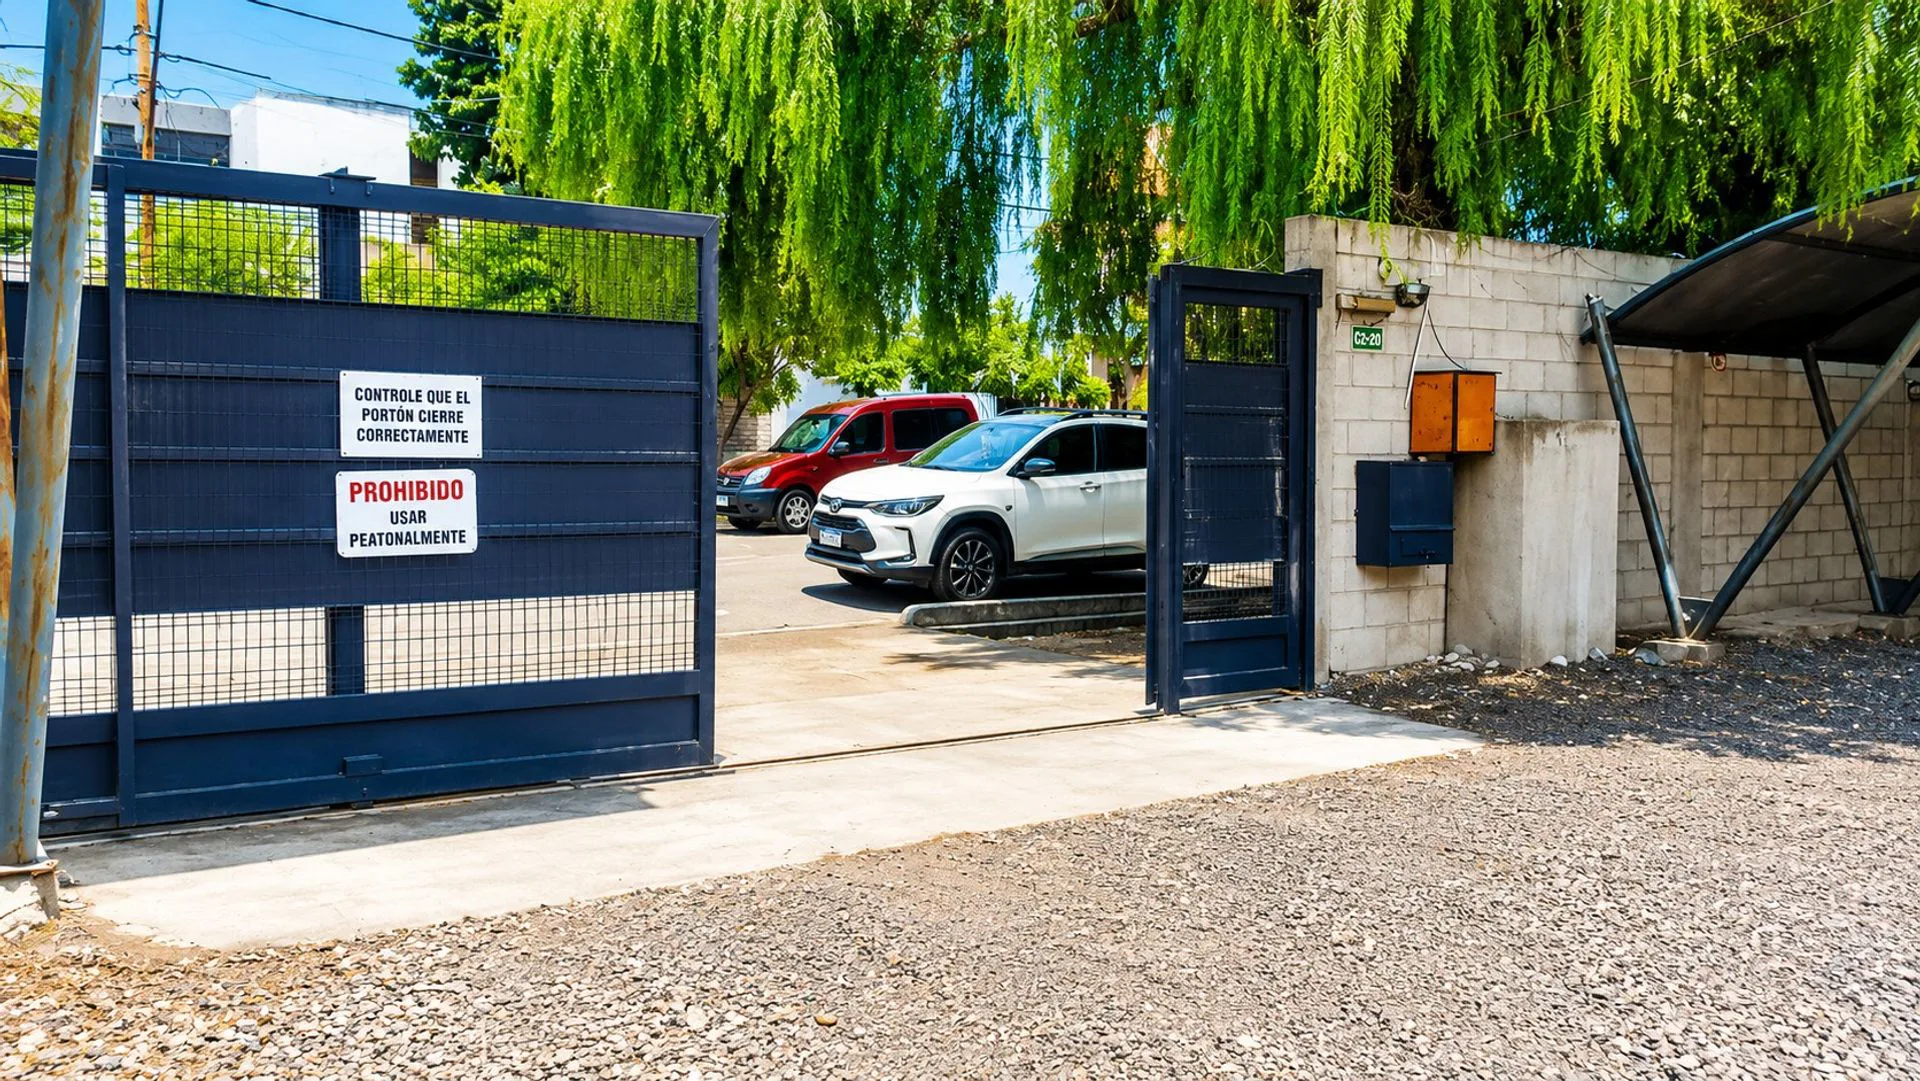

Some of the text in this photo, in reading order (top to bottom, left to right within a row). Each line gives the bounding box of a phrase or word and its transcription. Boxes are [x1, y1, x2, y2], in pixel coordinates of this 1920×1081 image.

[355, 387, 471, 405] CONTROLE QUE EL
[361, 405, 464, 424] PORTÓN CIERRE
[356, 428, 469, 443] CORRECTAMENTE
[349, 479, 464, 503] PROHIBIDO
[390, 510, 427, 525] USAR
[349, 529, 467, 548] PEATONALMENTE
